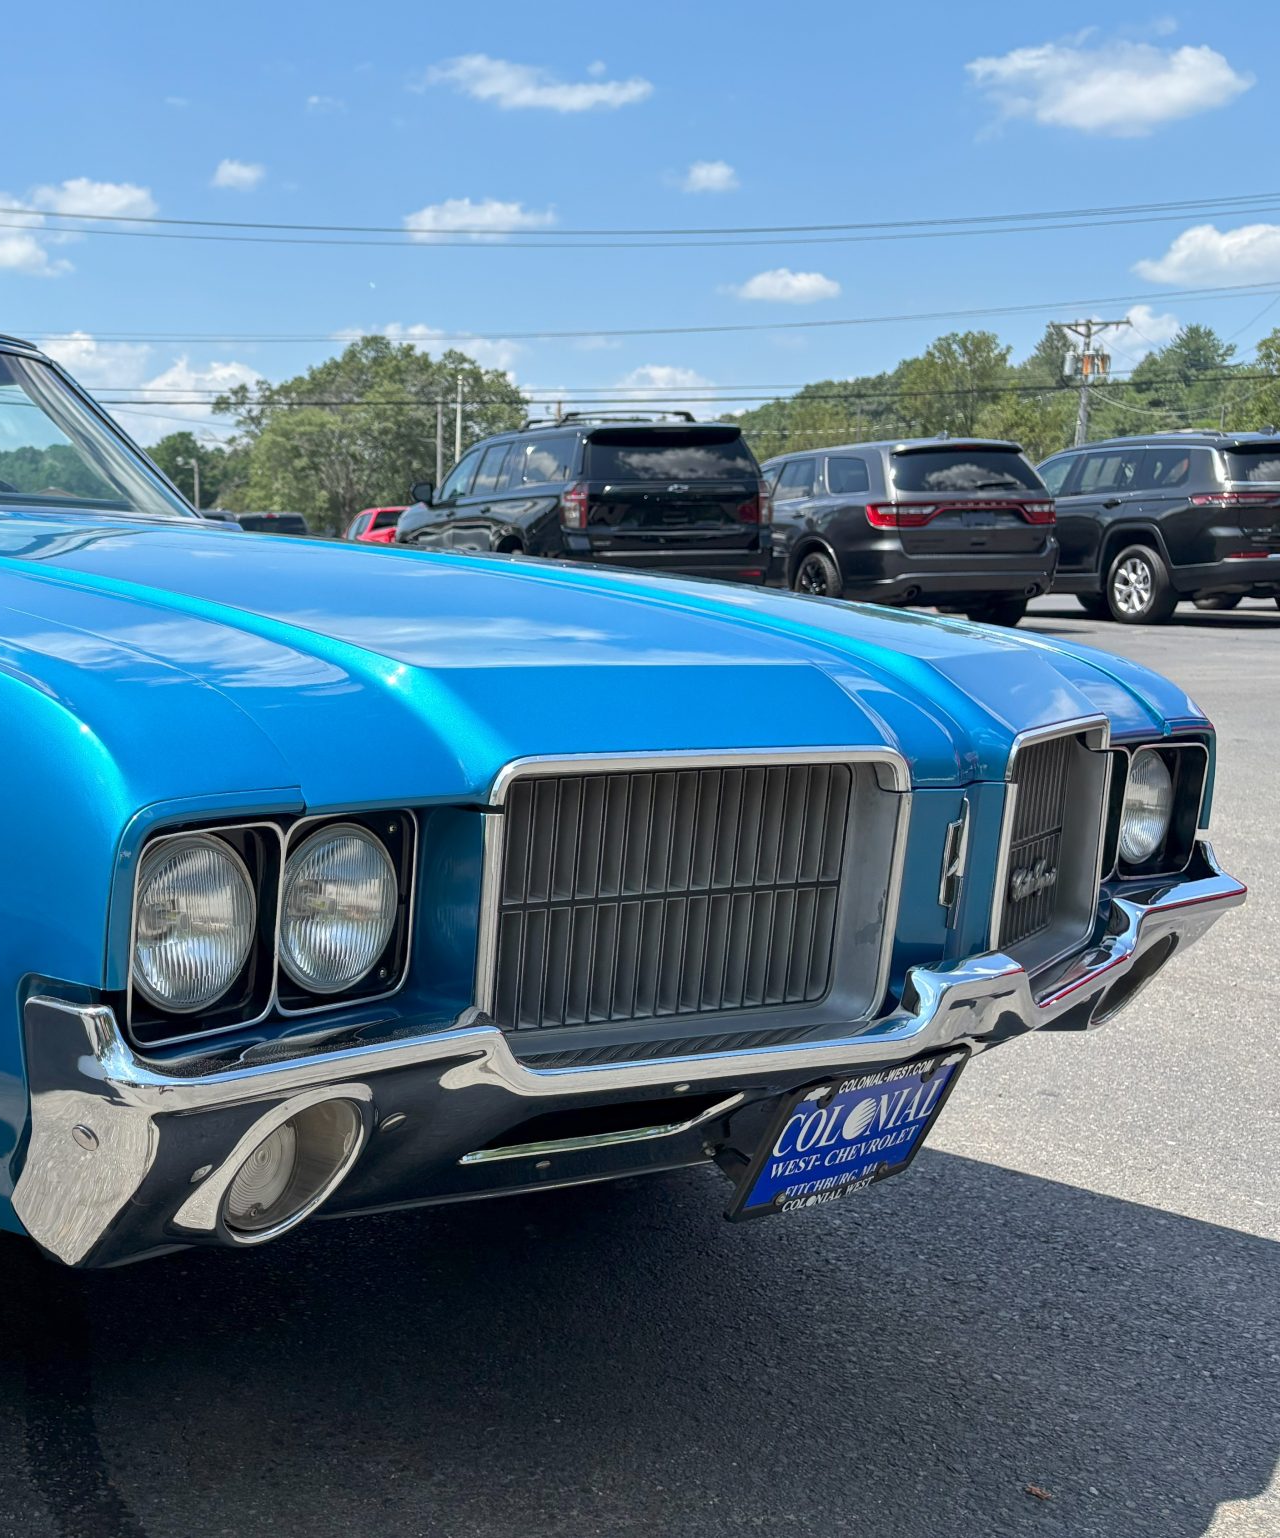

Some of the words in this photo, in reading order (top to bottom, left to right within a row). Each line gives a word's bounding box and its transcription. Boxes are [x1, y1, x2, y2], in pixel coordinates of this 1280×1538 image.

[838, 1058, 935, 1094] COLONIAL-WEST.COM
[772, 1078, 944, 1157] COLONIAL
[824, 1124, 919, 1167] CHEVROLET
[781, 1187, 844, 1213] COLONIAL
[845, 1175, 875, 1195] WEST
